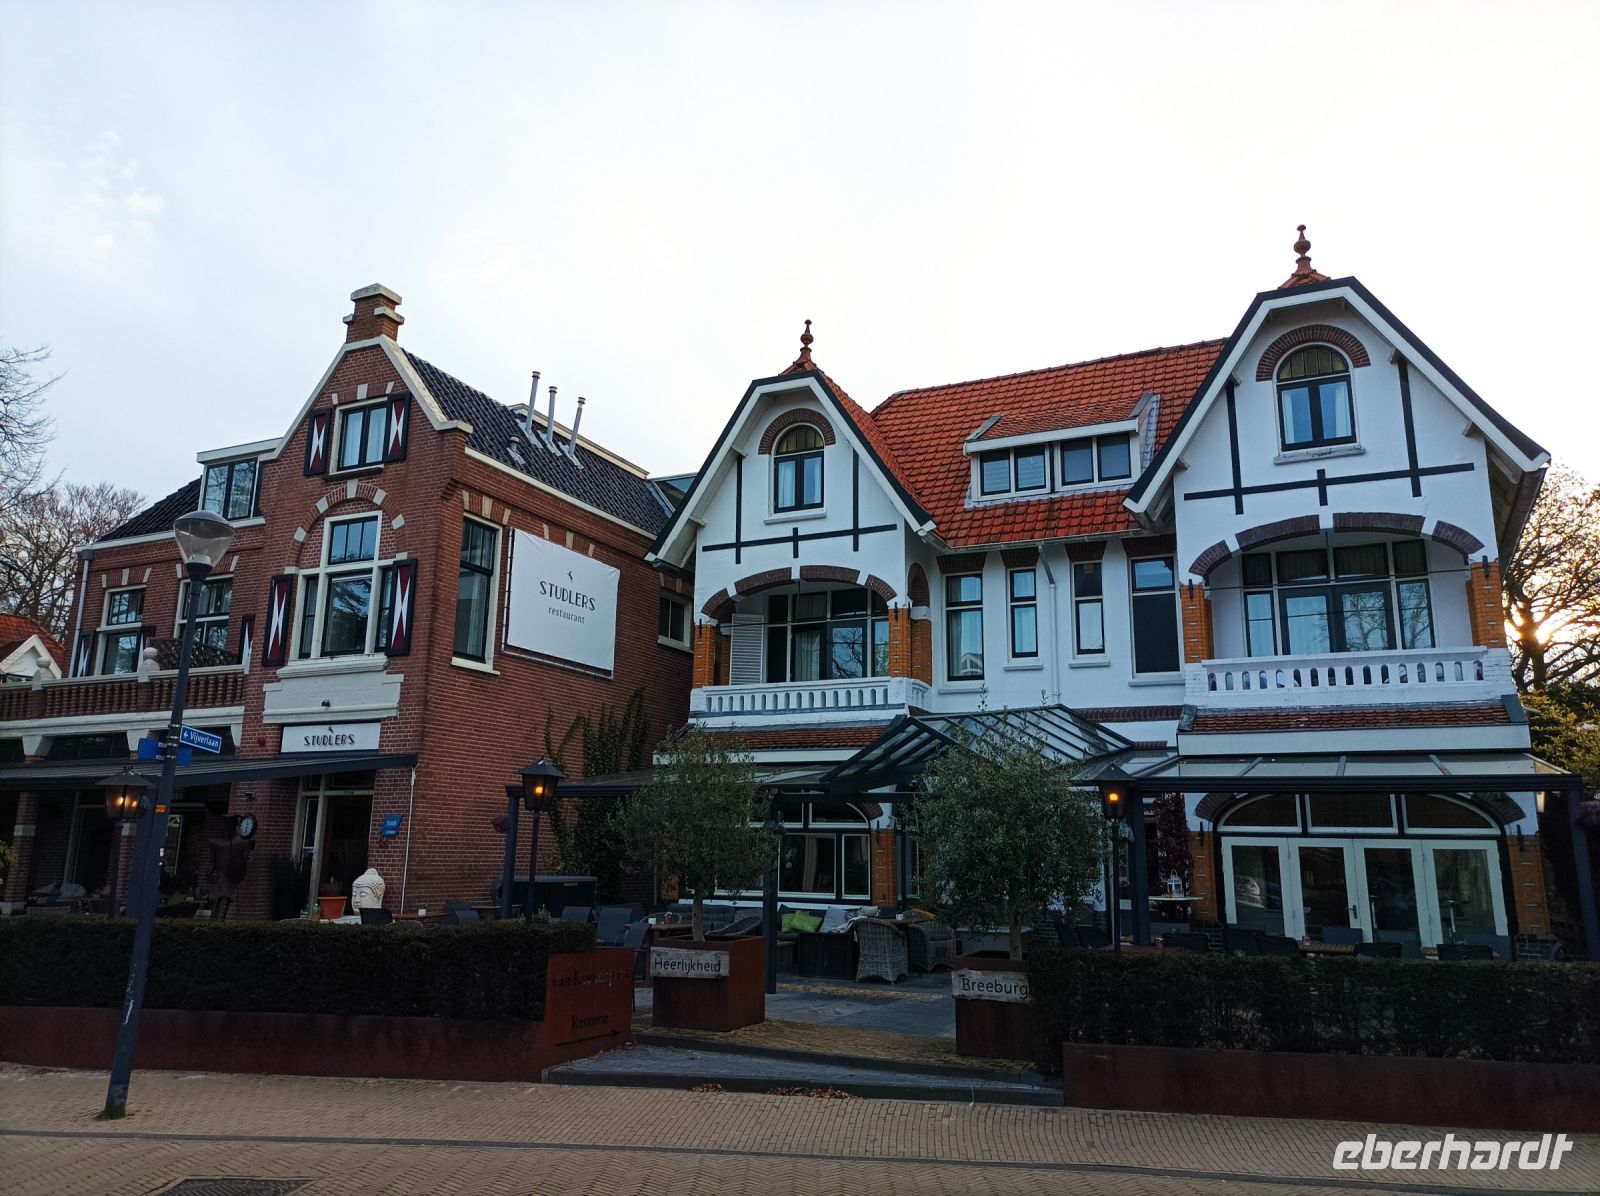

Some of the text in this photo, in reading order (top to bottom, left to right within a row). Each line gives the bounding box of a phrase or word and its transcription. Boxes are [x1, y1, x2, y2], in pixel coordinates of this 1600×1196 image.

[539, 580, 596, 611] STUDLERS
[548, 606, 585, 624] restaurant
[190, 731, 219, 747] Vijverlaan
[303, 733, 355, 747] STUDLERS
[654, 957, 721, 975] Heerlijkheid
[962, 977, 1028, 1000] Breeburg
